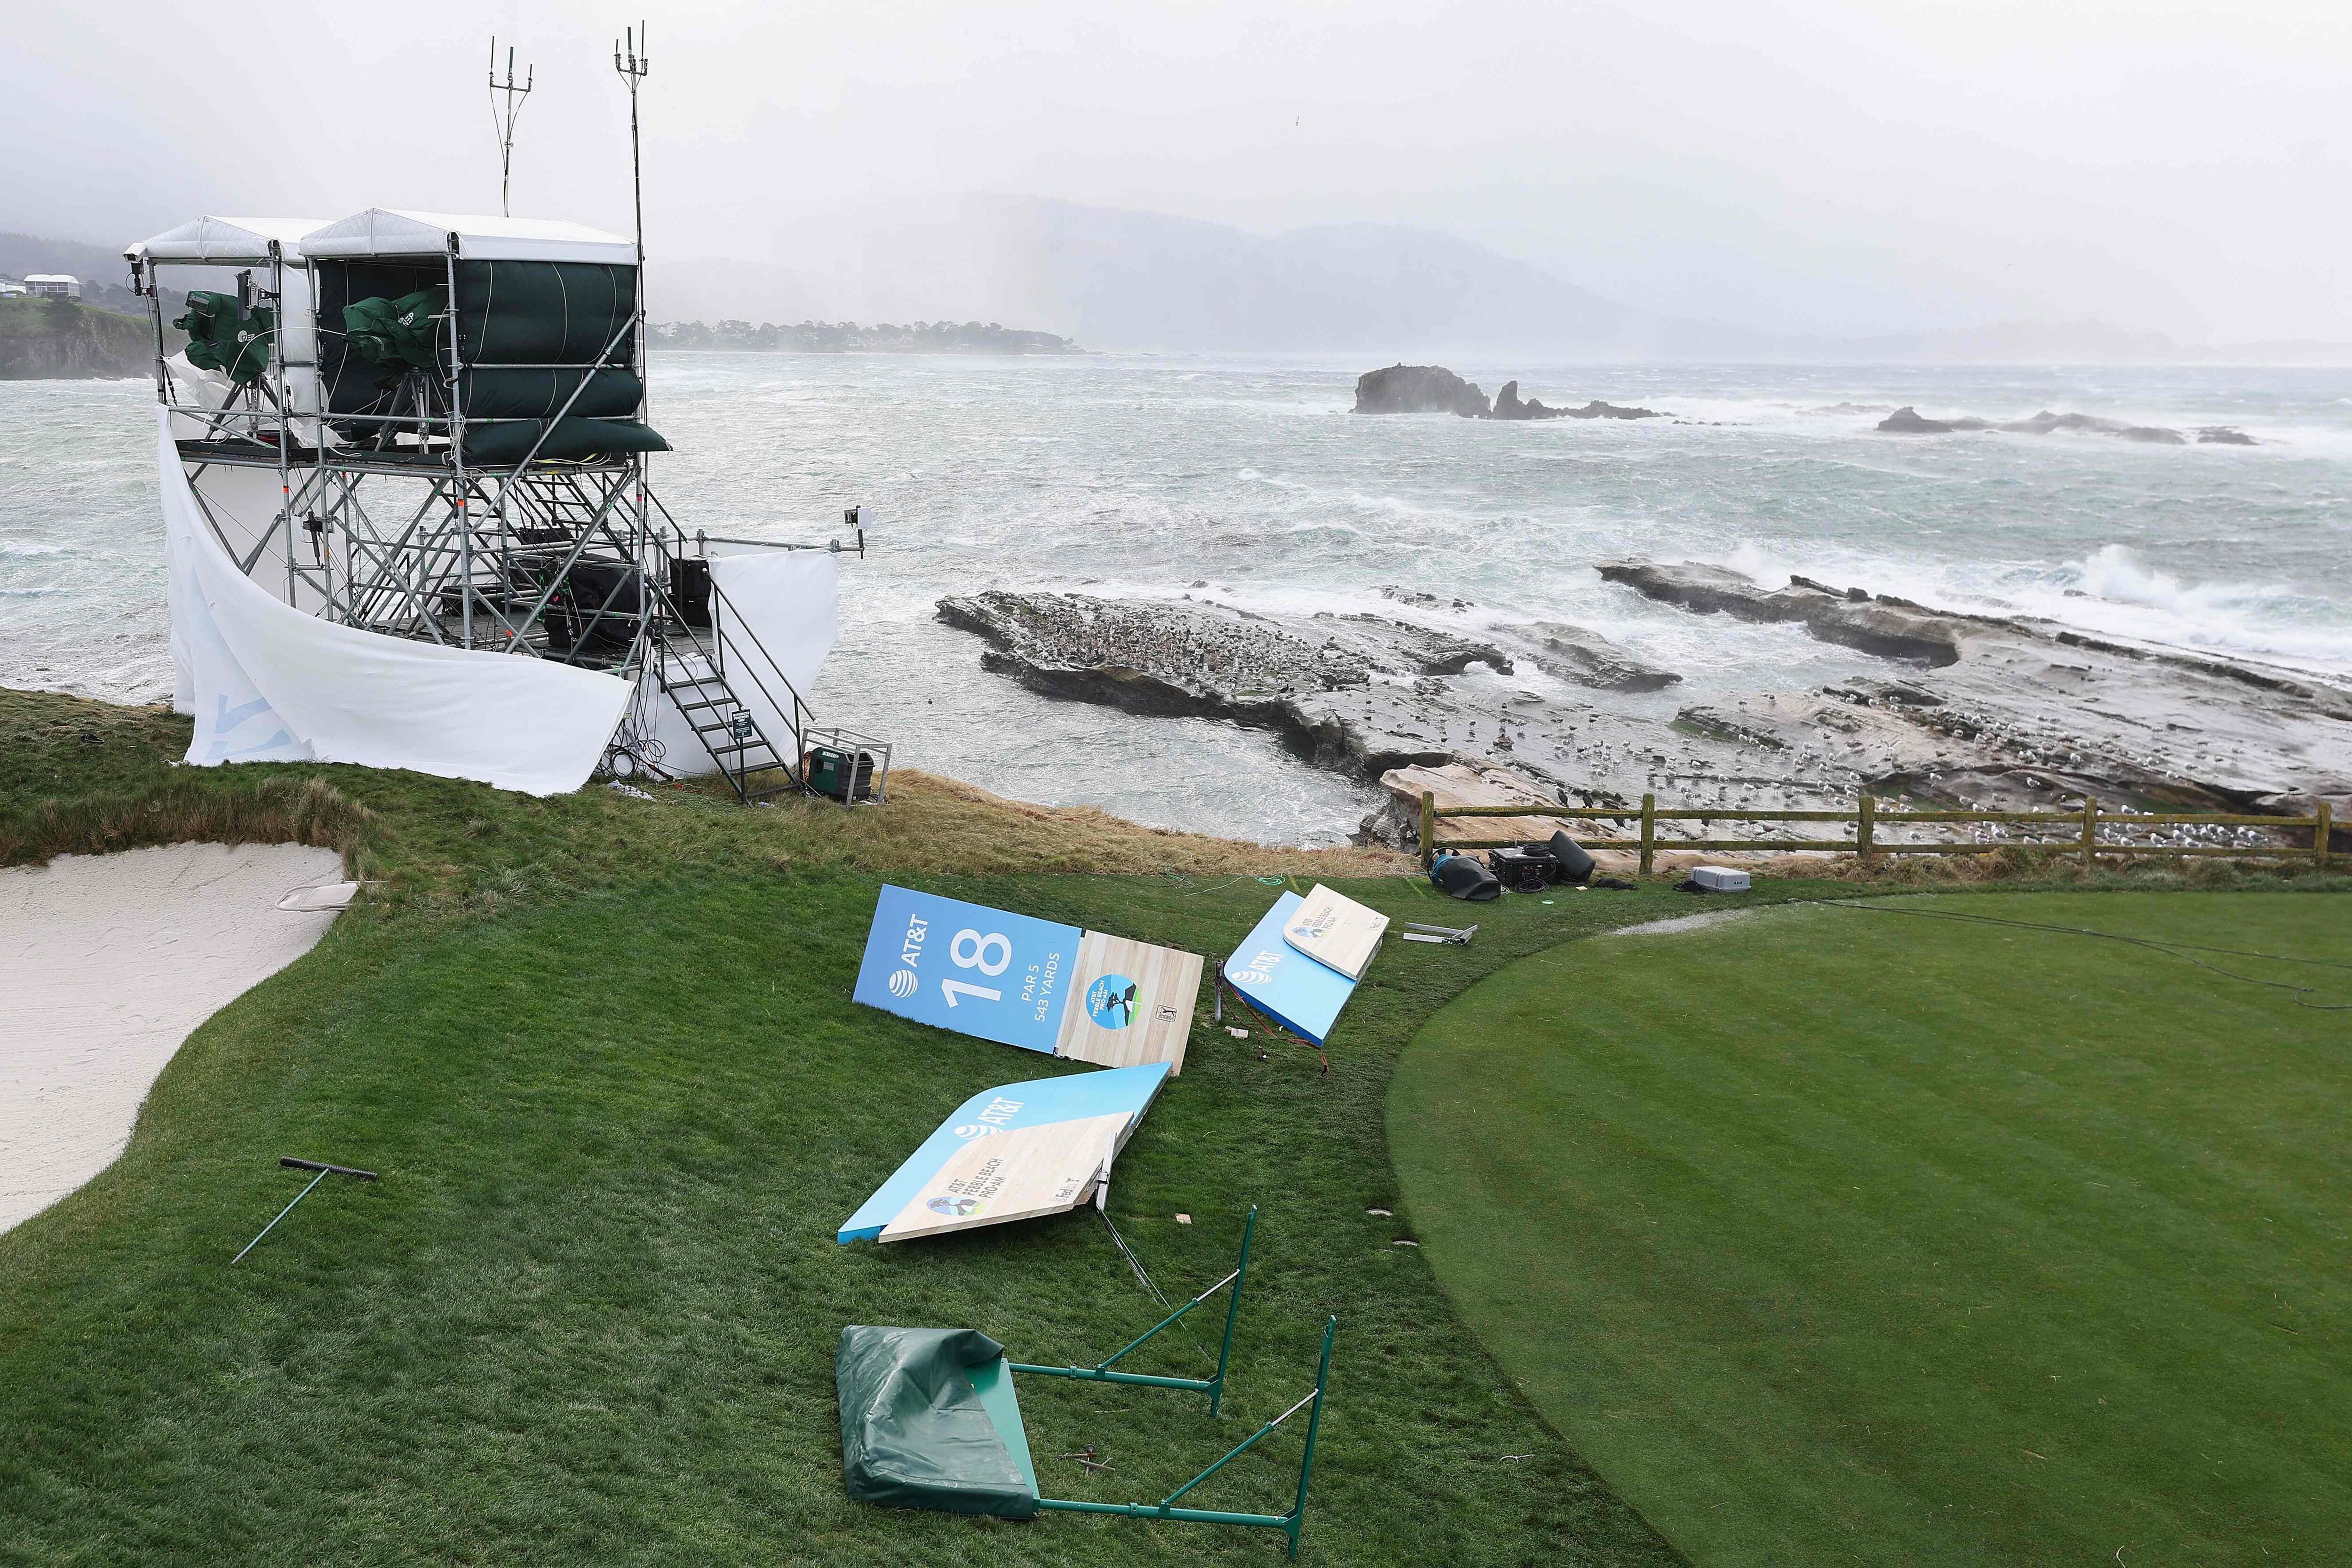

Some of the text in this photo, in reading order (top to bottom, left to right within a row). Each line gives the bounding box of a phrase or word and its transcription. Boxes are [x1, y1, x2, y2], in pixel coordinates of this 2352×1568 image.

[402, 312, 414, 327] NEP
[901, 913, 928, 968] AT&T
[941, 929, 1012, 1008] 18
[1248, 950, 1284, 972] AT&T
[1021, 964, 1039, 1002] PAR 5
[1034, 952, 1060, 1022] 543 YARDS
[1092, 997, 1101, 1017] PEBBLE
[1099, 989, 1108, 1011] PRO-AM
[977, 1097, 1025, 1126] AT&T
[947, 1179, 967, 1194] AT&T
[962, 1158, 1003, 1195] PEBBLE BEACH
[978, 1177, 1007, 1198] PRO-AM
